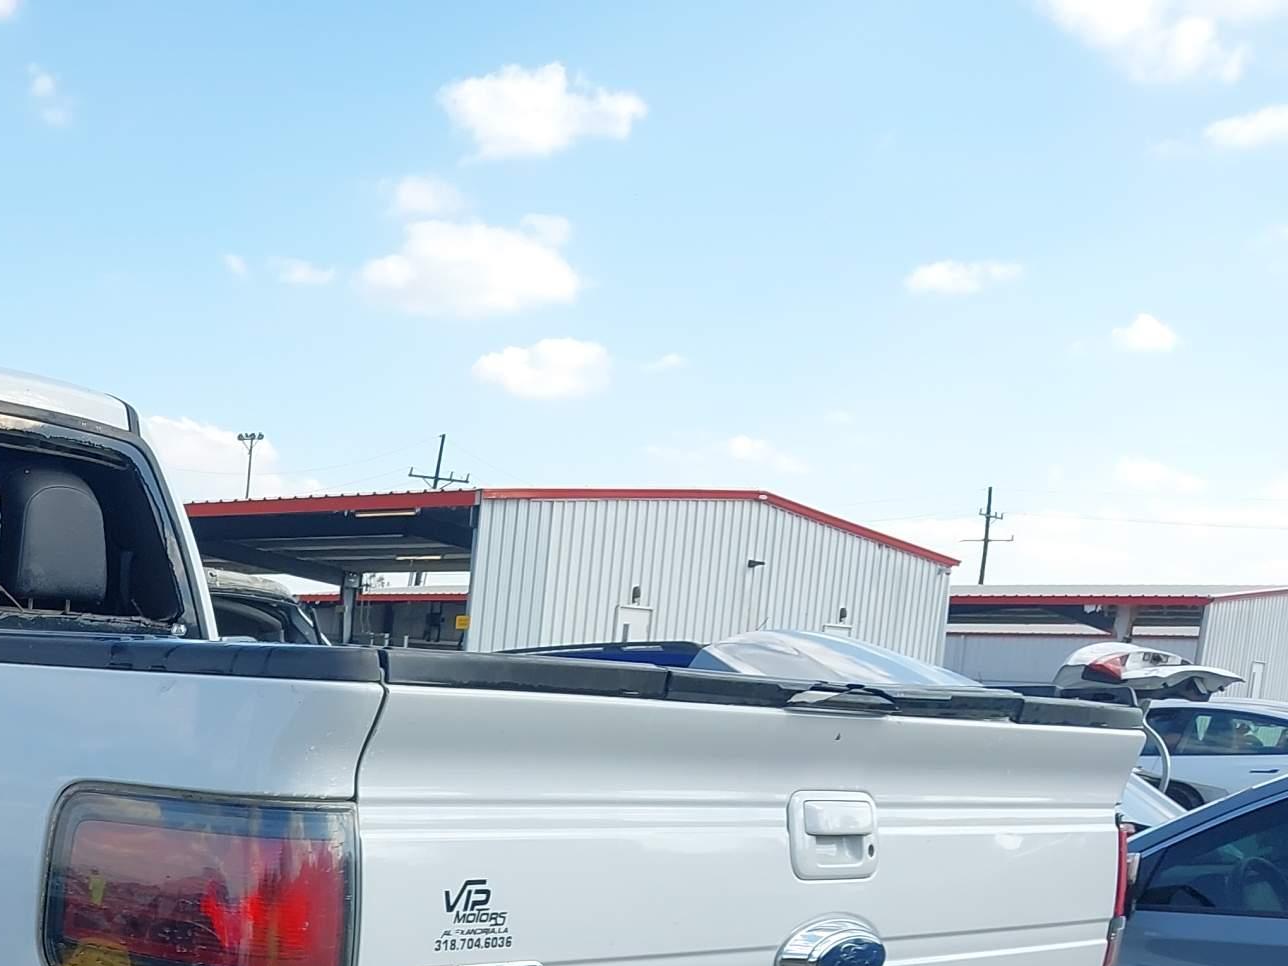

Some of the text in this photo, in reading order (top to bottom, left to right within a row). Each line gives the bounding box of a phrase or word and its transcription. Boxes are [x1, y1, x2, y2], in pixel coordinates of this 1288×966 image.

[444, 879, 492, 913] VIP
[453, 908, 508, 927] MOTORS
[434, 936, 513, 951] 318.704.6036
